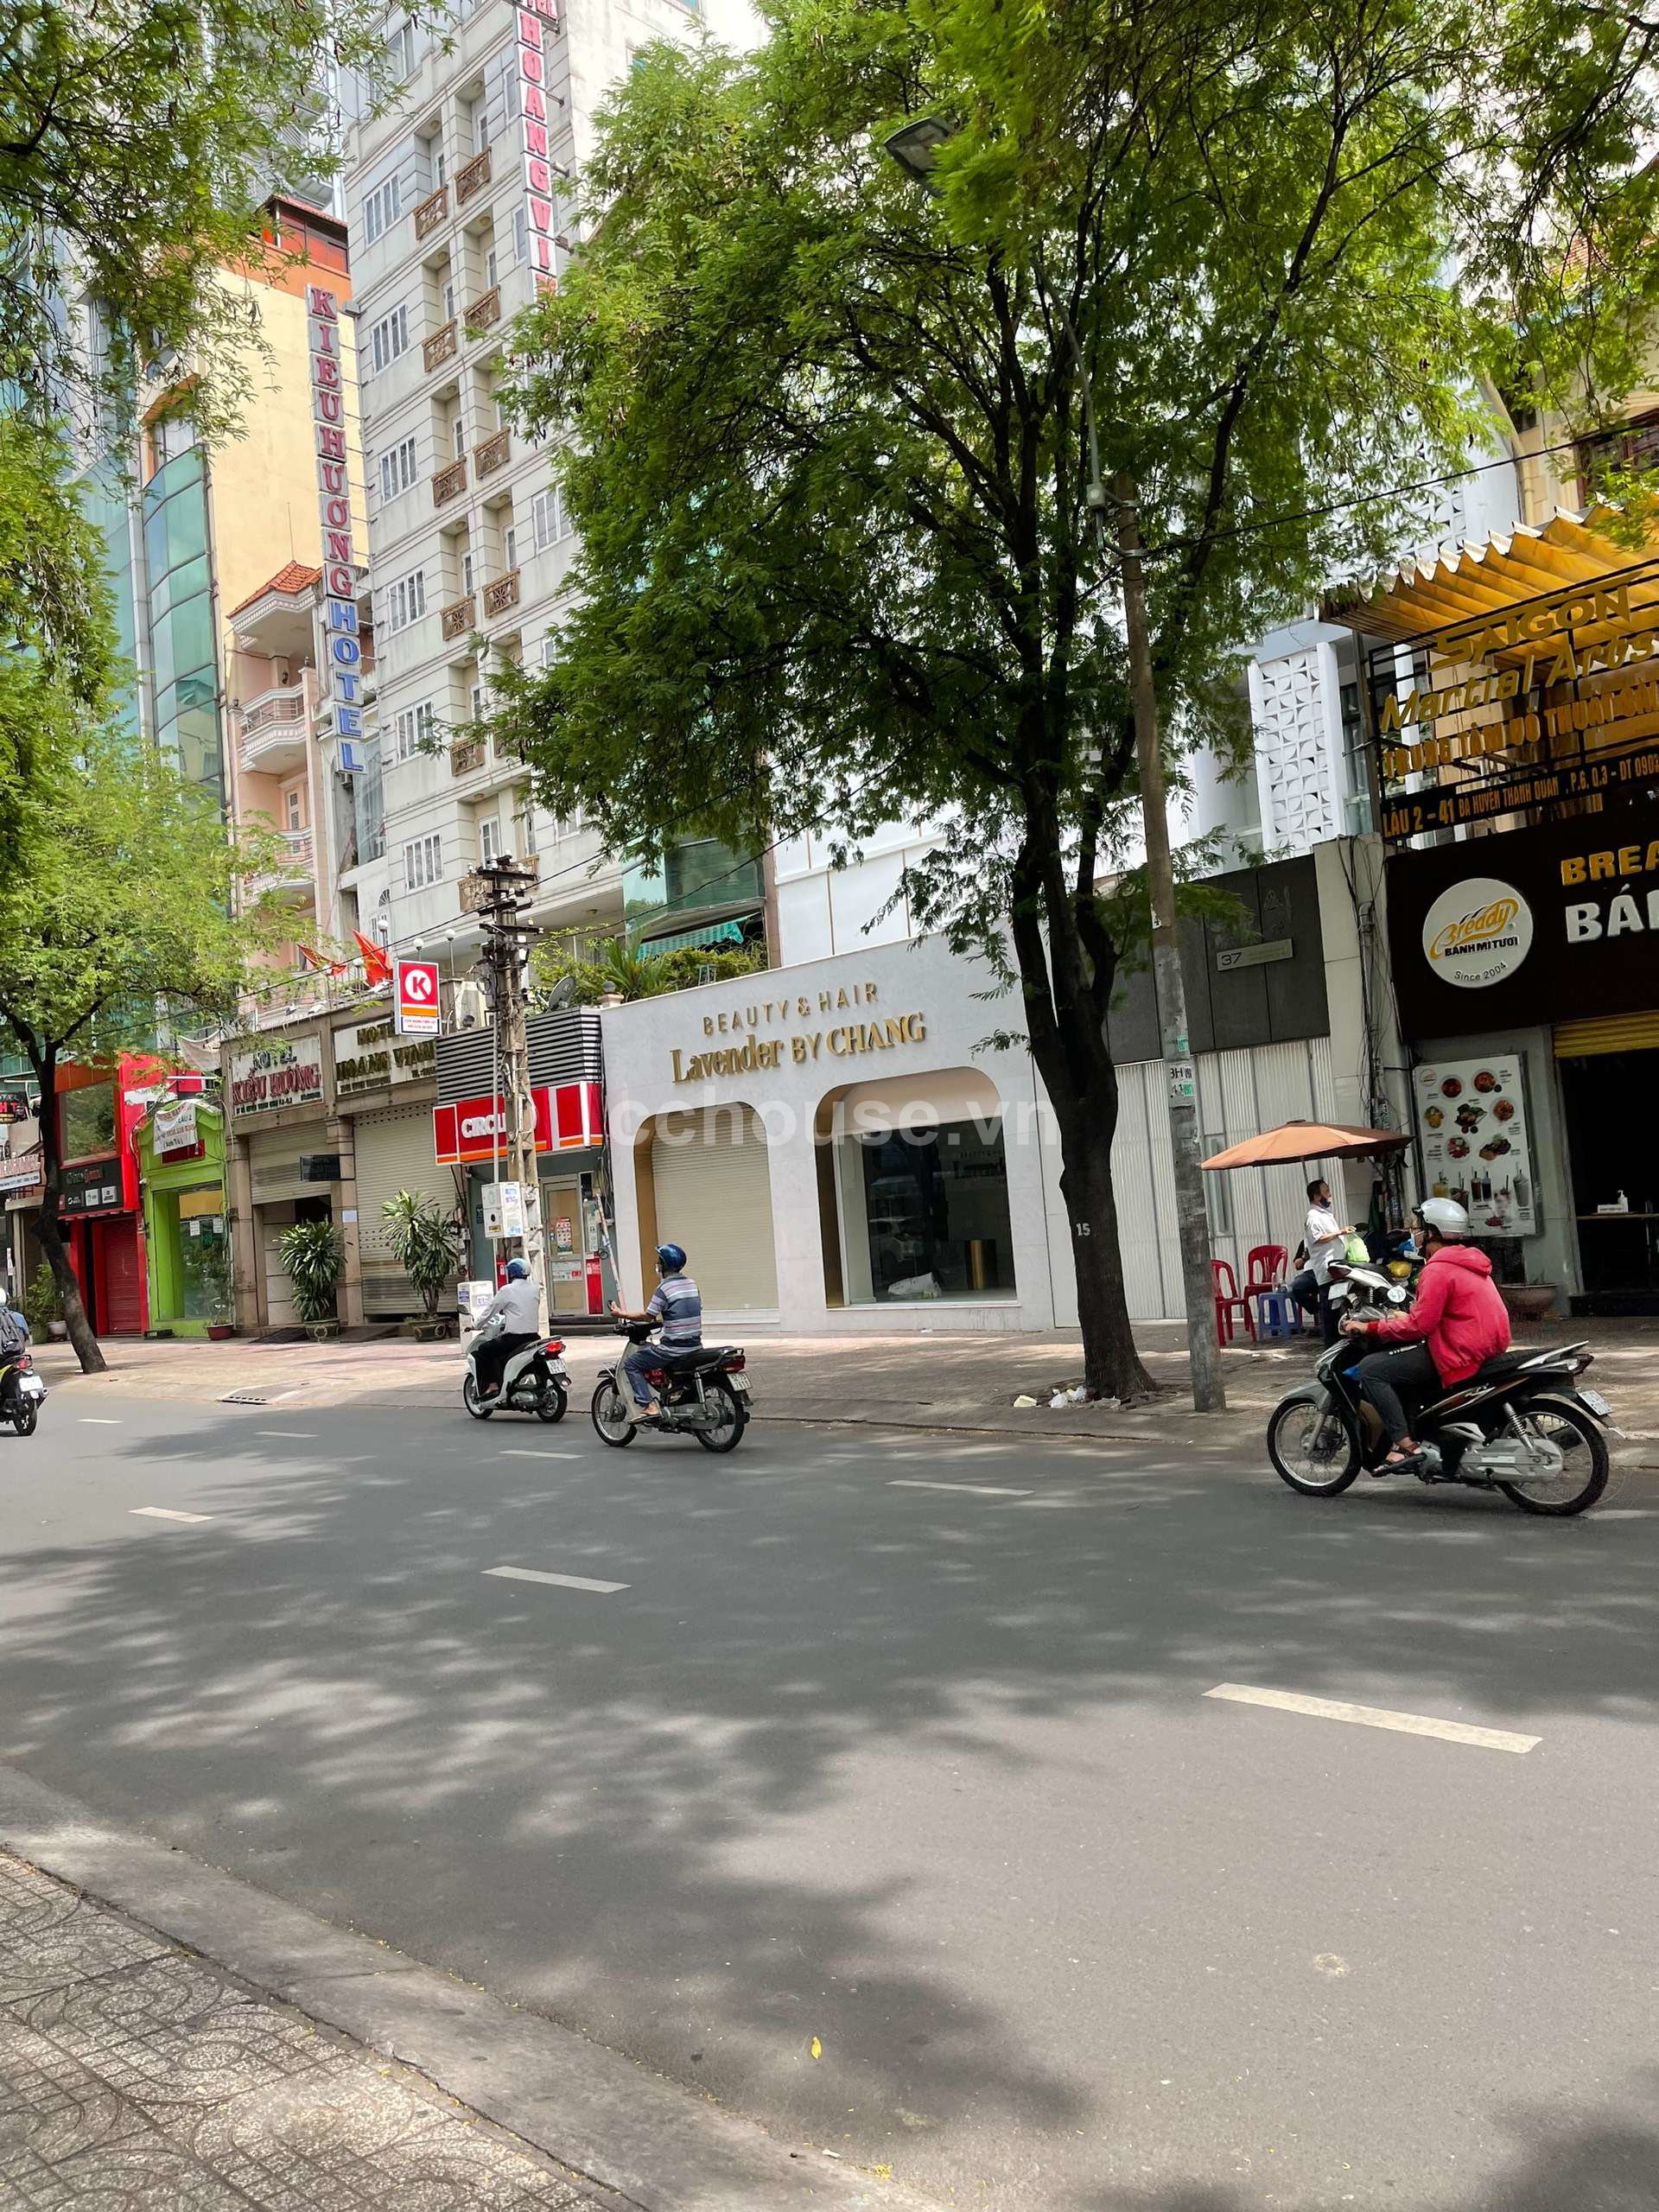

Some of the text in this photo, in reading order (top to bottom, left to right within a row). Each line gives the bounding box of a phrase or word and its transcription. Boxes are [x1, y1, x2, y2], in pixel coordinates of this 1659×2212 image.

[1428, 574, 1640, 671] SAIGON
[331, 601, 365, 772] HOTEL
[1382, 654, 1535, 734] Martial
[1384, 736, 1453, 779] TRUNG
[1414, 805, 1424, 830] 2
[1439, 798, 1455, 823] 41
[1503, 781, 1532, 807] THANH
[1534, 776, 1559, 800] QUAN
[1221, 952, 1243, 966] 37
[1454, 962, 1506, 982] Since 2004
[702, 982, 879, 1035] BEAUTY & HAIR
[670, 1011, 927, 1084] Lavender BY CHANG
[1075, 1222, 1091, 1236] 15
